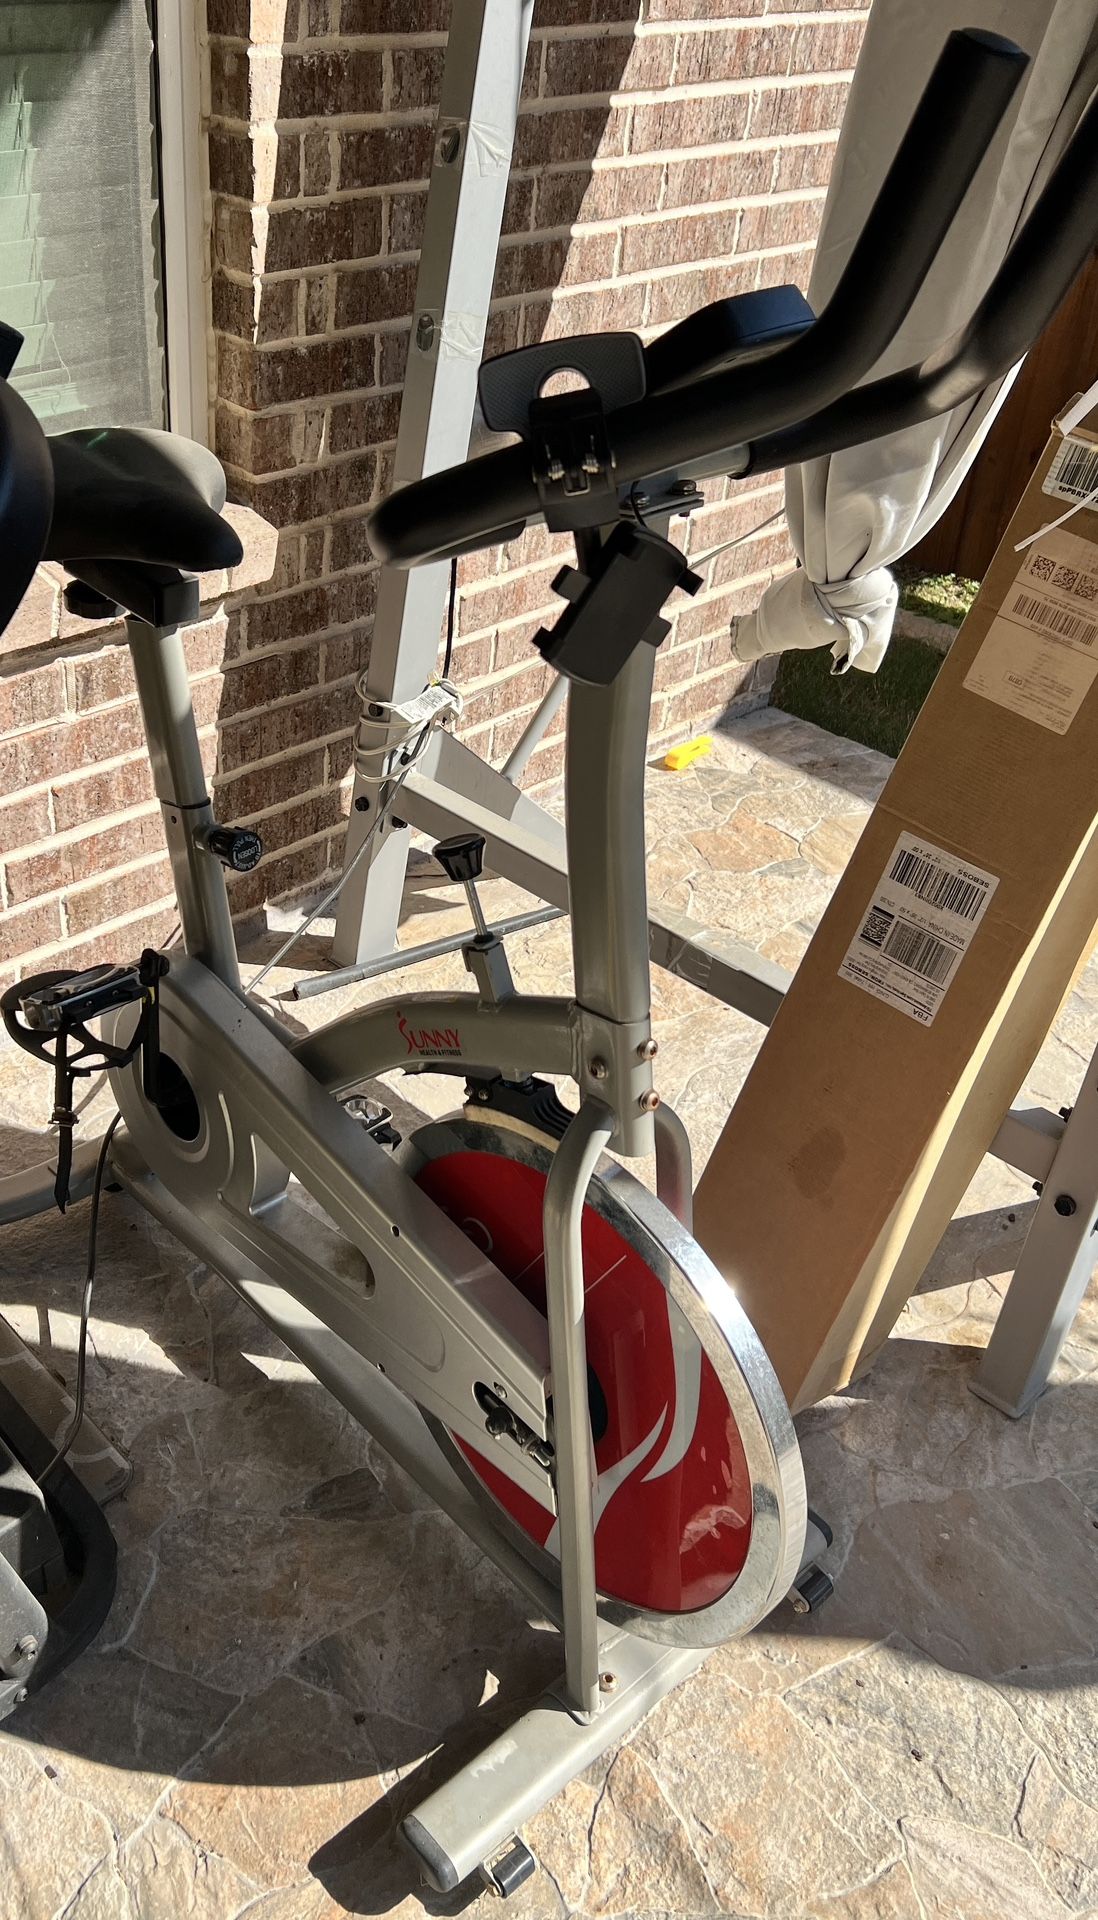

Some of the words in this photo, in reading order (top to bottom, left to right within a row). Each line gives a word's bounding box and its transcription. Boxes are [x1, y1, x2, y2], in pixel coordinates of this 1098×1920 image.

[238, 845, 258, 860] LOOSEN
[957, 868, 989, 888] SEBOSS
[927, 921, 944, 933] CHINA
[949, 933, 965, 945] MADE
[847, 962, 869, 976] SEBOSS
[912, 1008, 929, 1022] FBA
[397, 1011, 461, 1055] SUNNY
